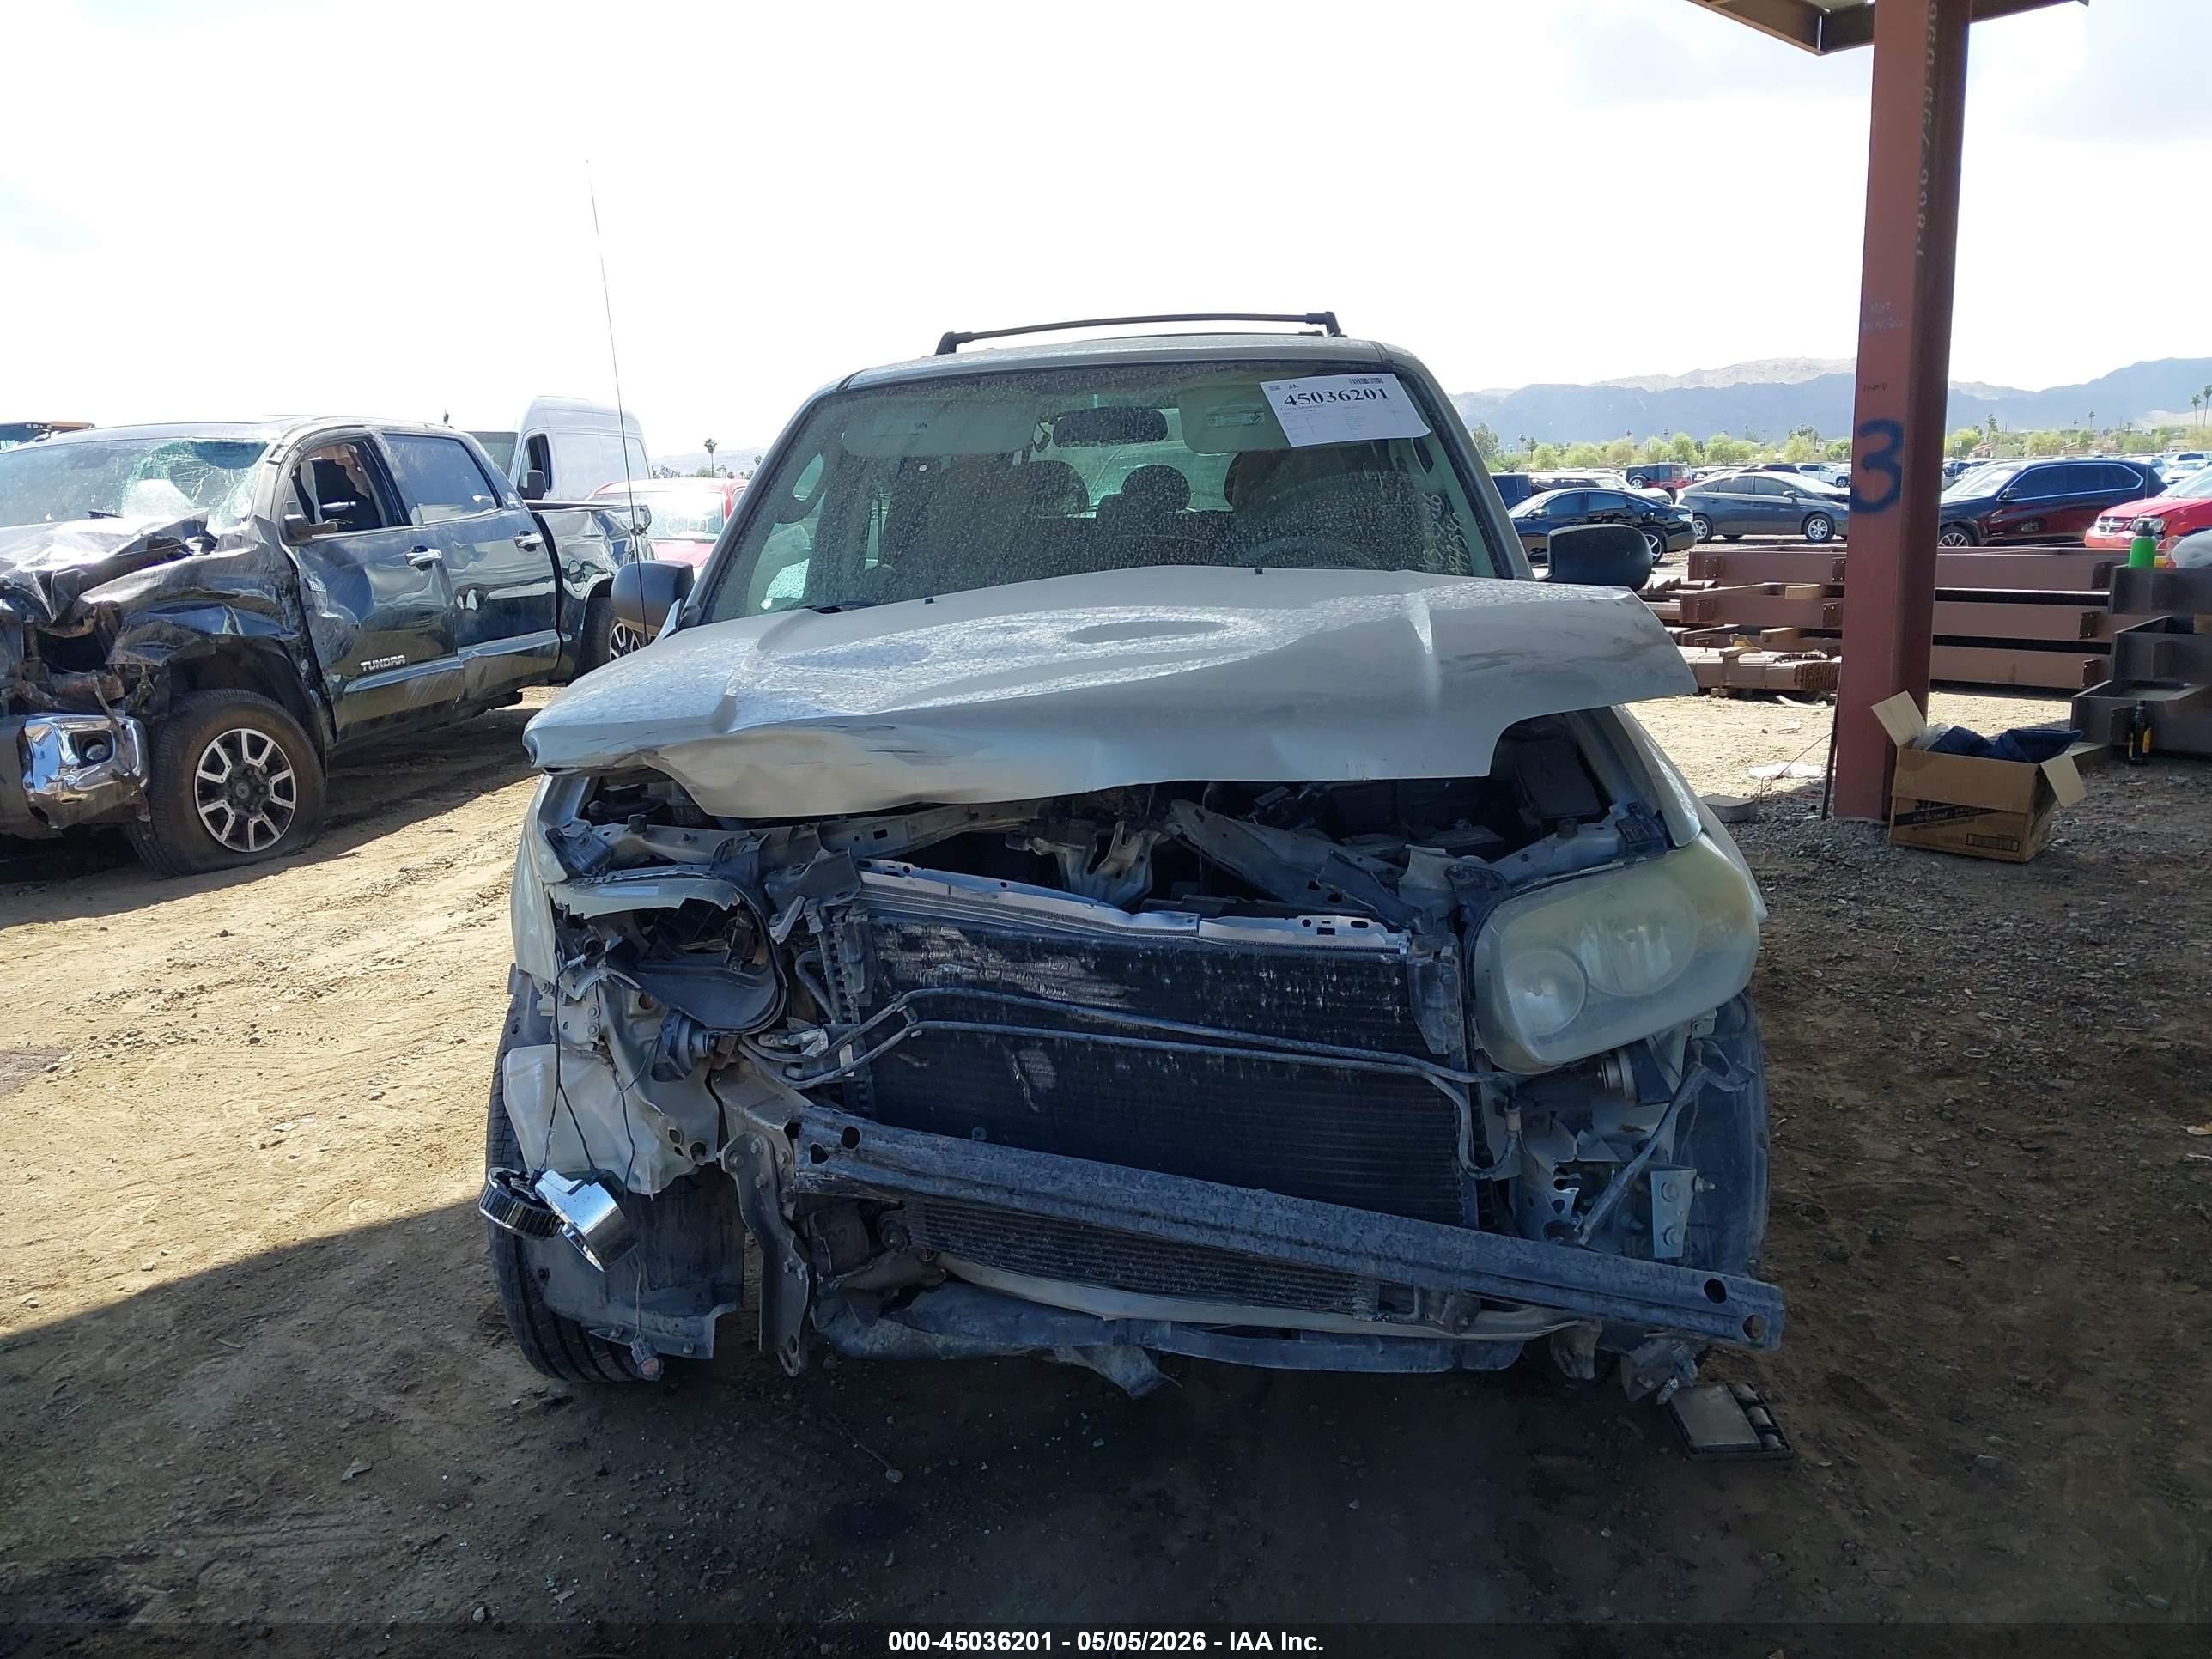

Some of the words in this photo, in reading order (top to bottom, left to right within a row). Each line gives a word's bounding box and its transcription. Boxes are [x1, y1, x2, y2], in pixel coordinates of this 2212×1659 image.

[1285, 387, 1389, 406] 45036201
[1850, 417, 1905, 515] 3
[359, 654, 406, 672] TUNDRA
